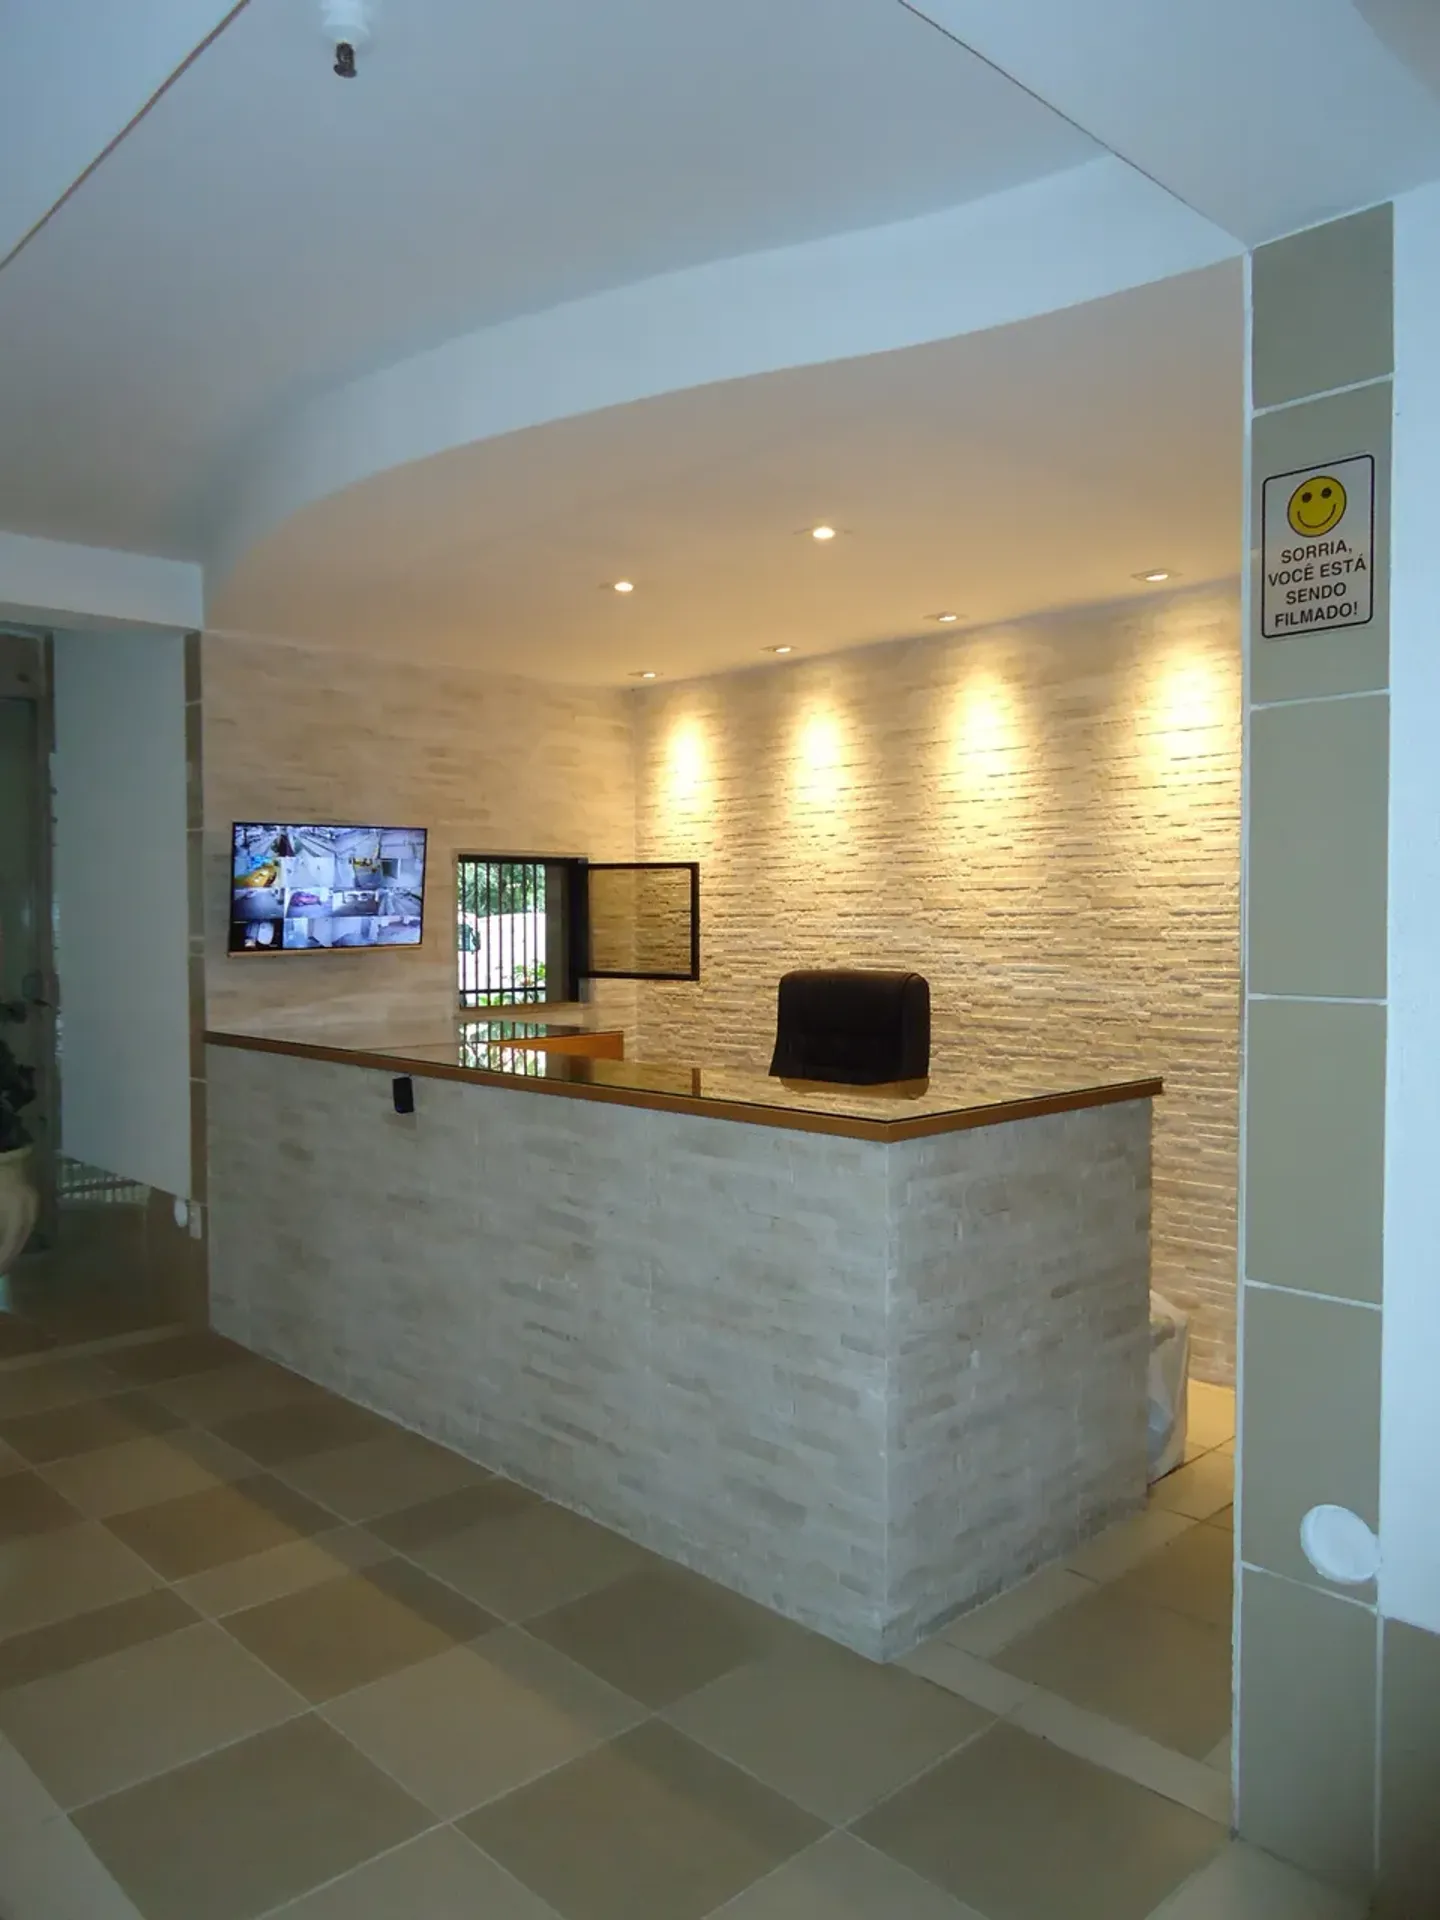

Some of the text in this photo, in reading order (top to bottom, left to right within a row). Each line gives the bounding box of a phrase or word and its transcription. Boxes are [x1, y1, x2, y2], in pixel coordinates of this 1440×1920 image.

[1281, 539, 1352, 564] SORRIA,
[1320, 554, 1367, 578] ESTÁ
[1286, 582, 1347, 605] SENDO
[1274, 601, 1358, 628] FILMADO!
